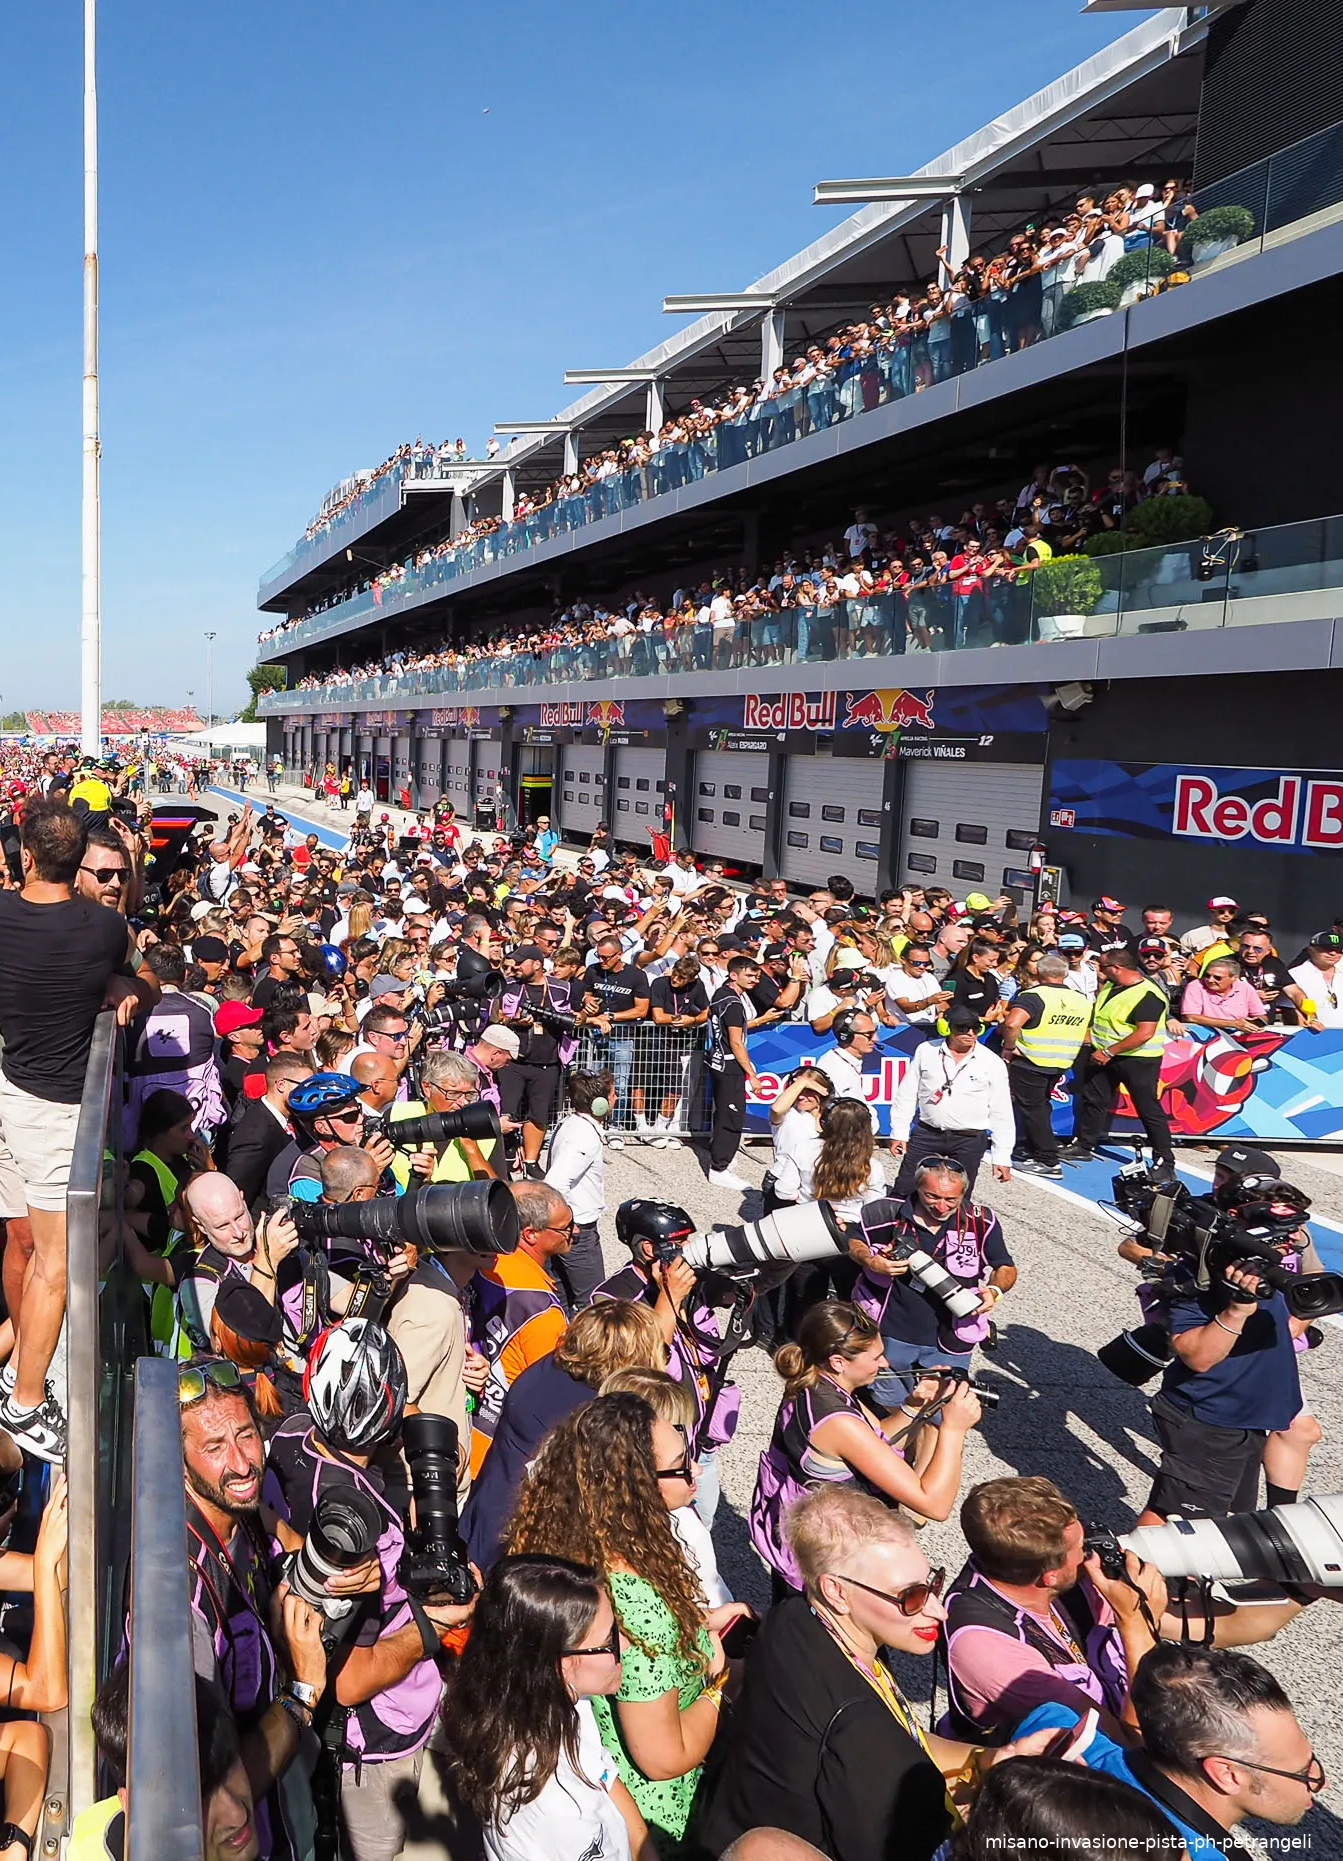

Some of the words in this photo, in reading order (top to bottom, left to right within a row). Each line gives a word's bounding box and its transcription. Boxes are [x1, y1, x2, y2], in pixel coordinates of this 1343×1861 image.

[540, 702, 561, 726] Red
[561, 701, 583, 726] Bull
[744, 691, 788, 729] Red
[788, 690, 837, 730] Bull
[899, 746, 932, 757] Maverick
[933, 744, 966, 758] VIÑALES
[978, 734, 994, 746] 12
[1172, 774, 1302, 845] Red
[306, 1295, 314, 1317] NPS
[352, 1291, 365, 1307] NPS
